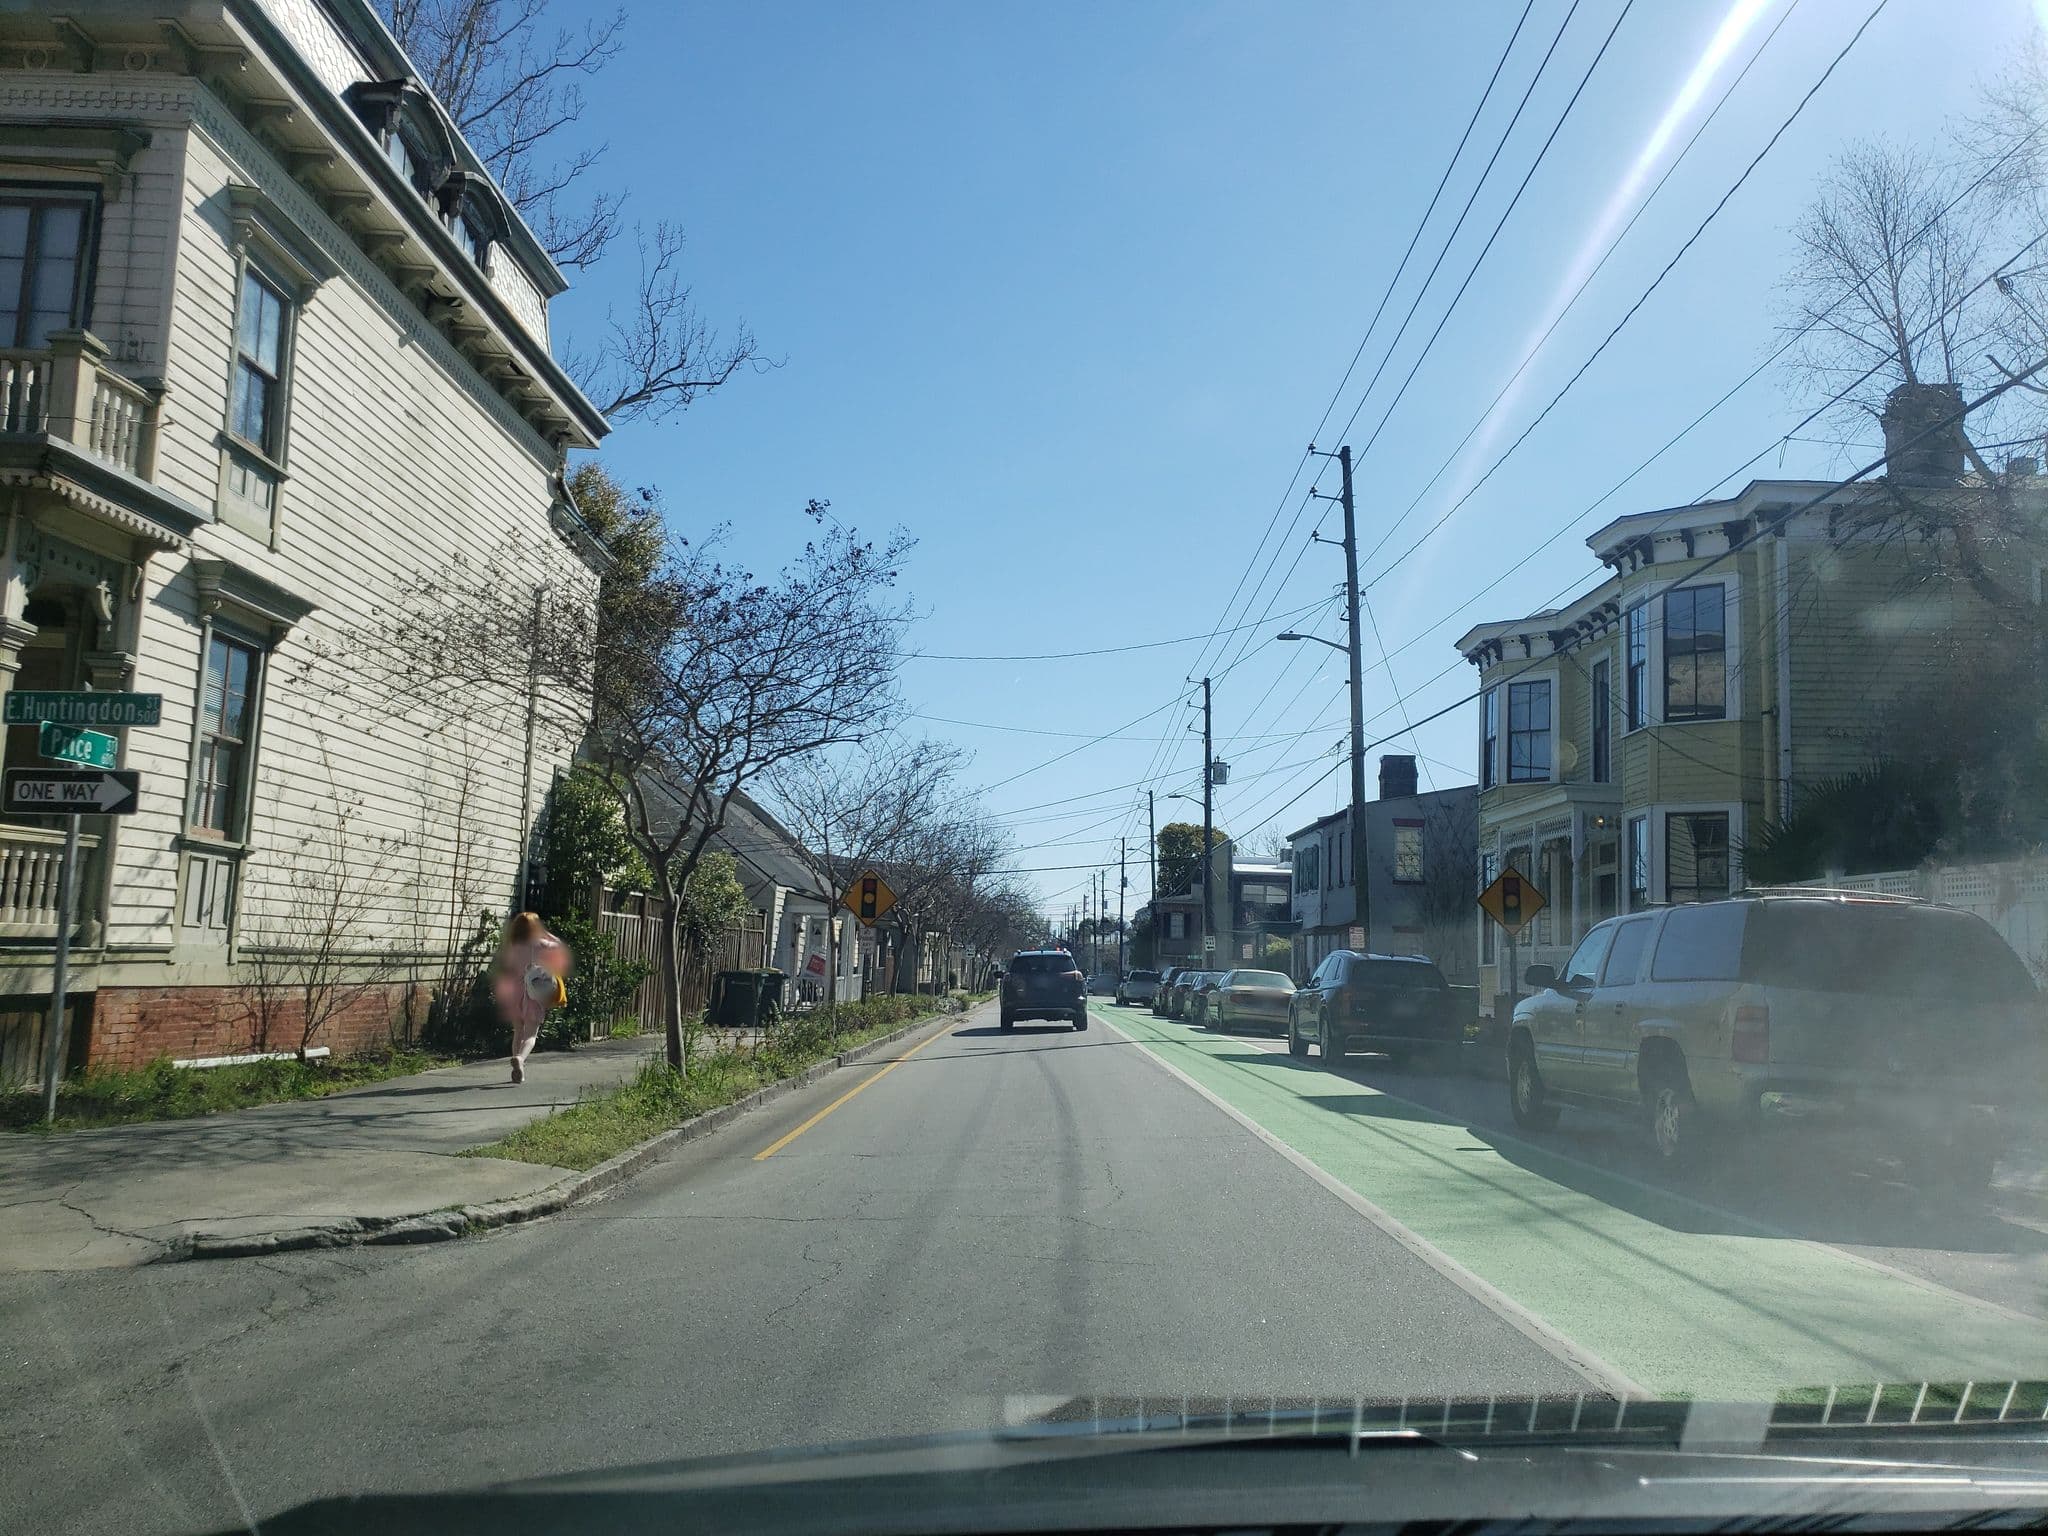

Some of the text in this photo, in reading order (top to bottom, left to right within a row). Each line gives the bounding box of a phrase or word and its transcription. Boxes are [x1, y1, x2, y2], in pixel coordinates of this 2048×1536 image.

[147, 696, 159, 709] ST
[51, 728, 92, 760] Price
[18, 783, 100, 800] ONE WAY
